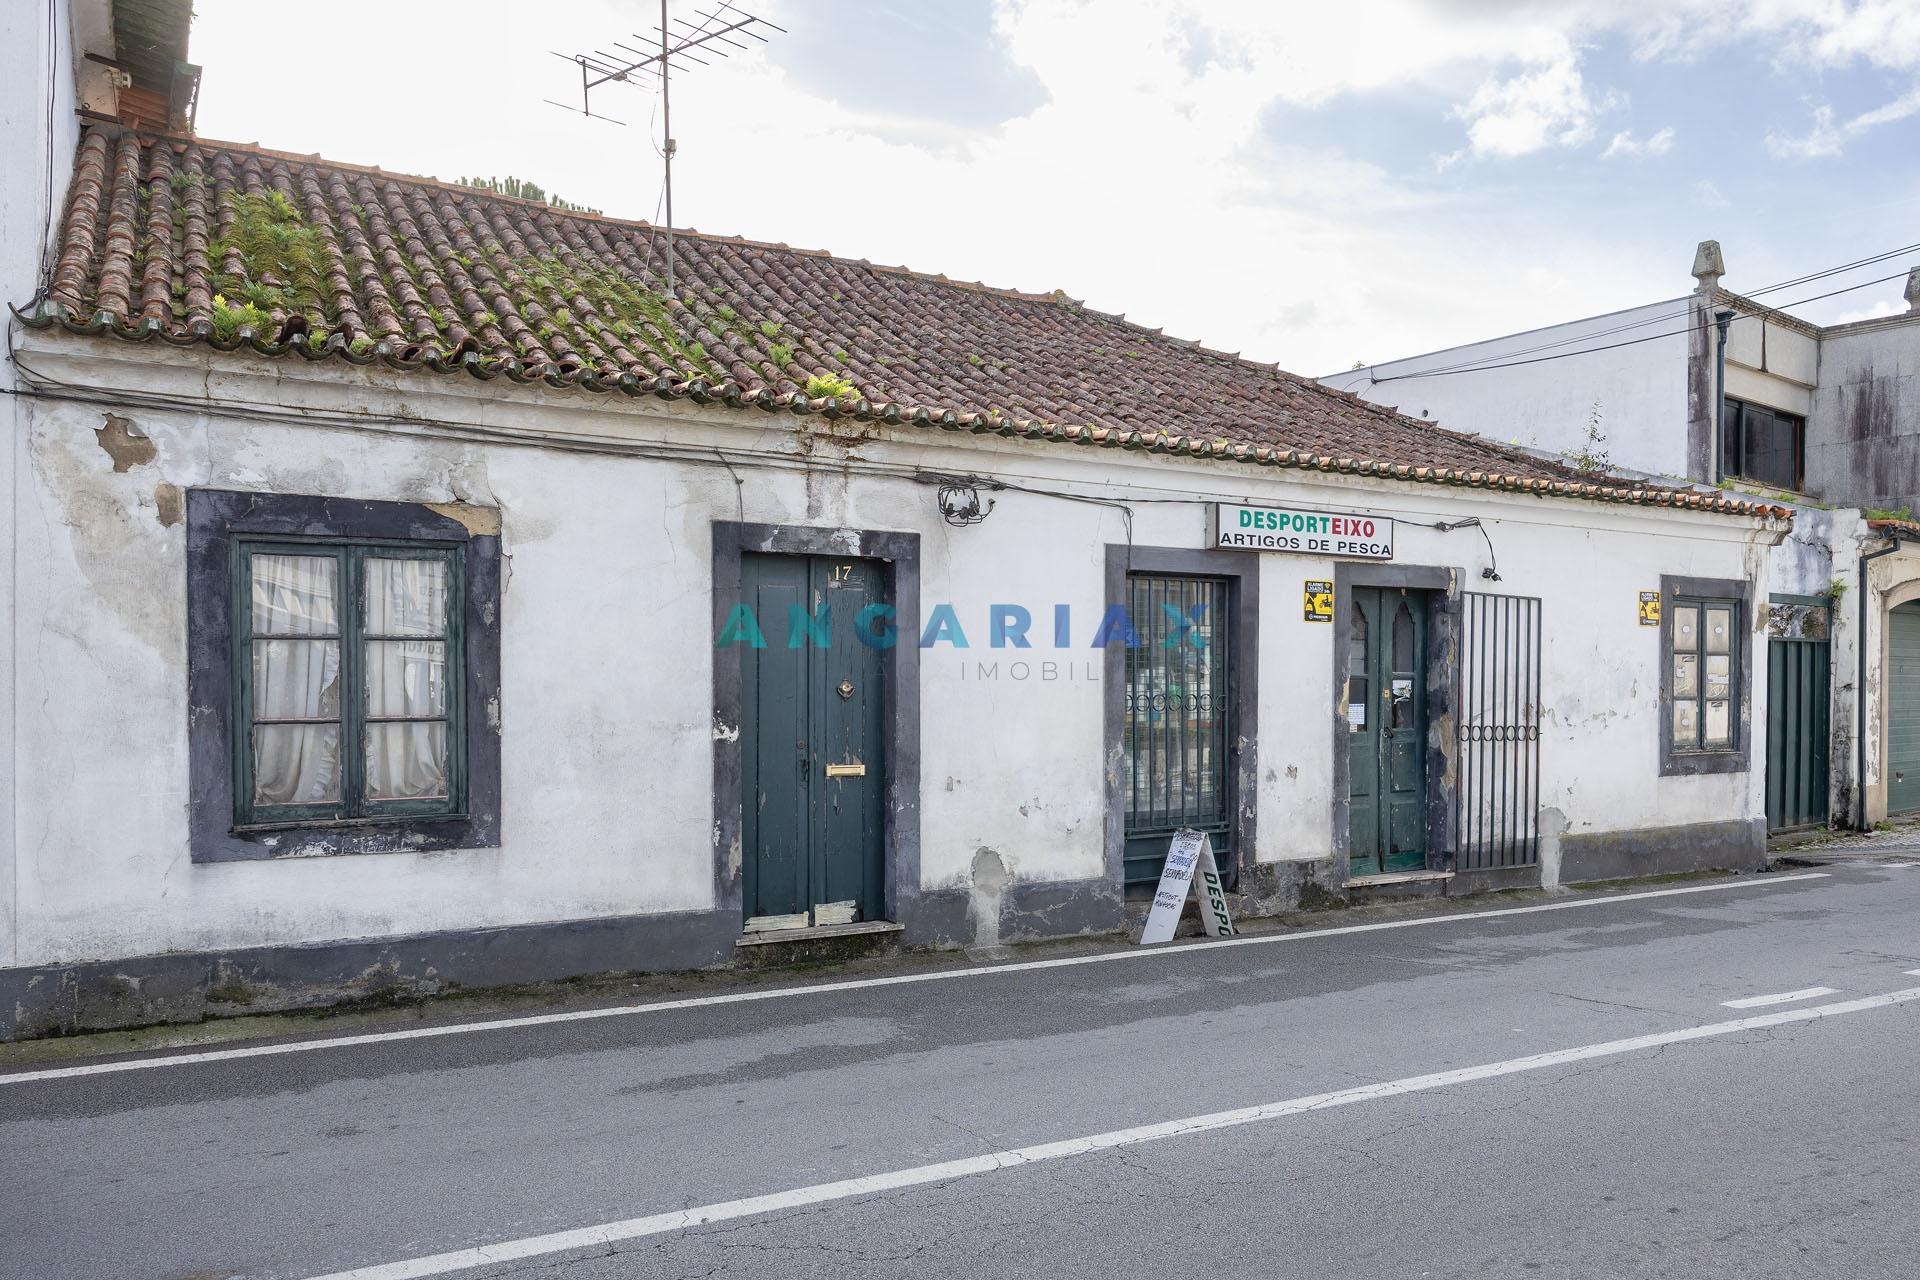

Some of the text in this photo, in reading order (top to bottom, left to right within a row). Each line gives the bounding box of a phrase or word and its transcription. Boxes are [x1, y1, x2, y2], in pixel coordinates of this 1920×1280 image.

[1240, 510, 1375, 538] DESPORTEIXO
[1221, 533, 1392, 556] ARTIGOS DE PESCA
[835, 565, 852, 580] 17
